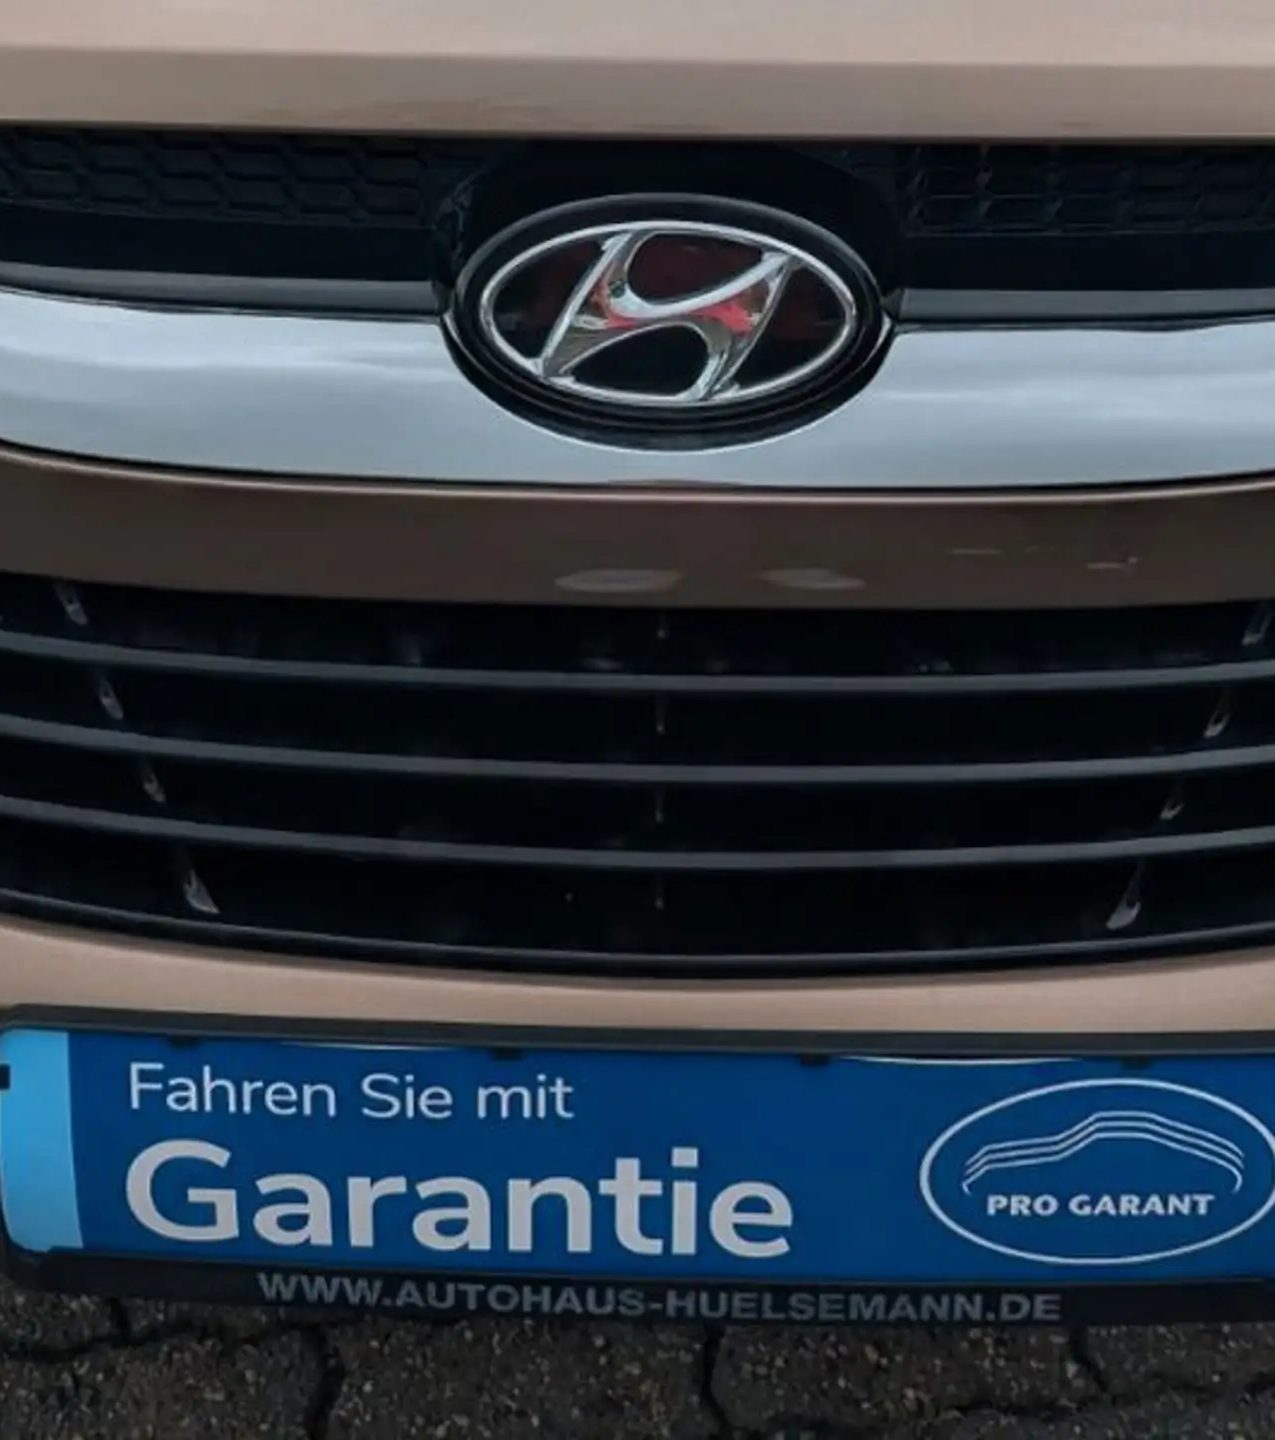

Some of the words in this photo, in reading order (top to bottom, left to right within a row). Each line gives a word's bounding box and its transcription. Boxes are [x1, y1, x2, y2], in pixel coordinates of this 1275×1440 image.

[130, 1061, 336, 1117] Fahren
[360, 1073, 454, 1120] Sie
[476, 1074, 575, 1120] mit
[126, 1138, 794, 1258] Garantie
[986, 1193, 1059, 1217] PRO
[1068, 1193, 1216, 1217] GARANT
[257, 1271, 1063, 1323] WWW.AUTOHAUS-HUELSEMANN.DE
